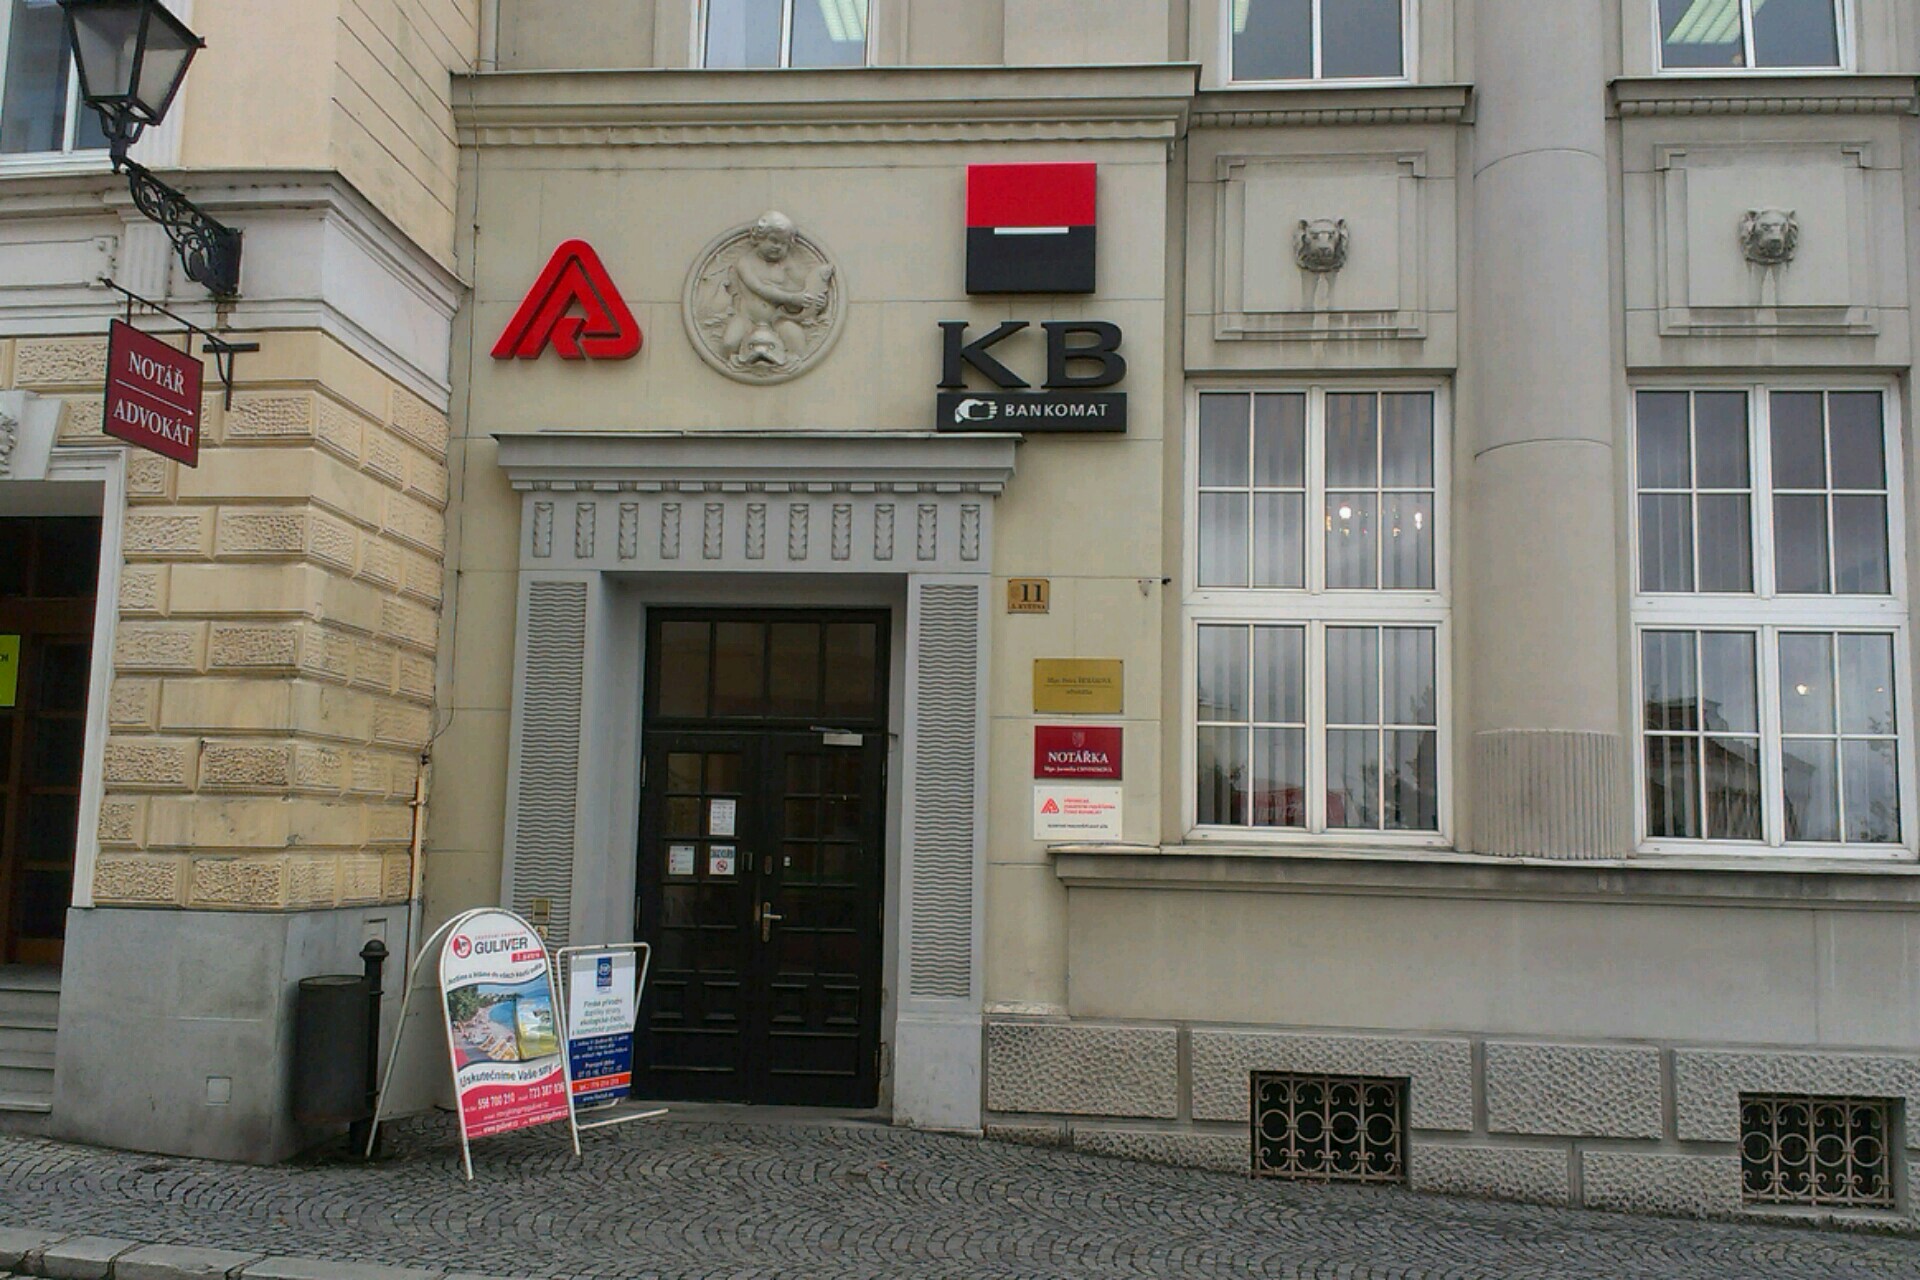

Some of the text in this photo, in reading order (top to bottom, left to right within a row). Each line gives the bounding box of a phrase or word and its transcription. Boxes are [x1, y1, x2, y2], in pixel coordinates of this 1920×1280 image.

[936, 321, 1127, 388] KB
[128, 350, 185, 396] NOTÁŘ
[1005, 403, 1108, 417] BANKOMAT
[113, 398, 194, 447] ADVOKÁT
[1021, 583, 1044, 602] 11
[1048, 750, 1109, 763] NOTÁŘKA
[474, 937, 528, 955] GULIVER
[518, 1068, 537, 1080] Vaše
[538, 1064, 553, 1075] sny
